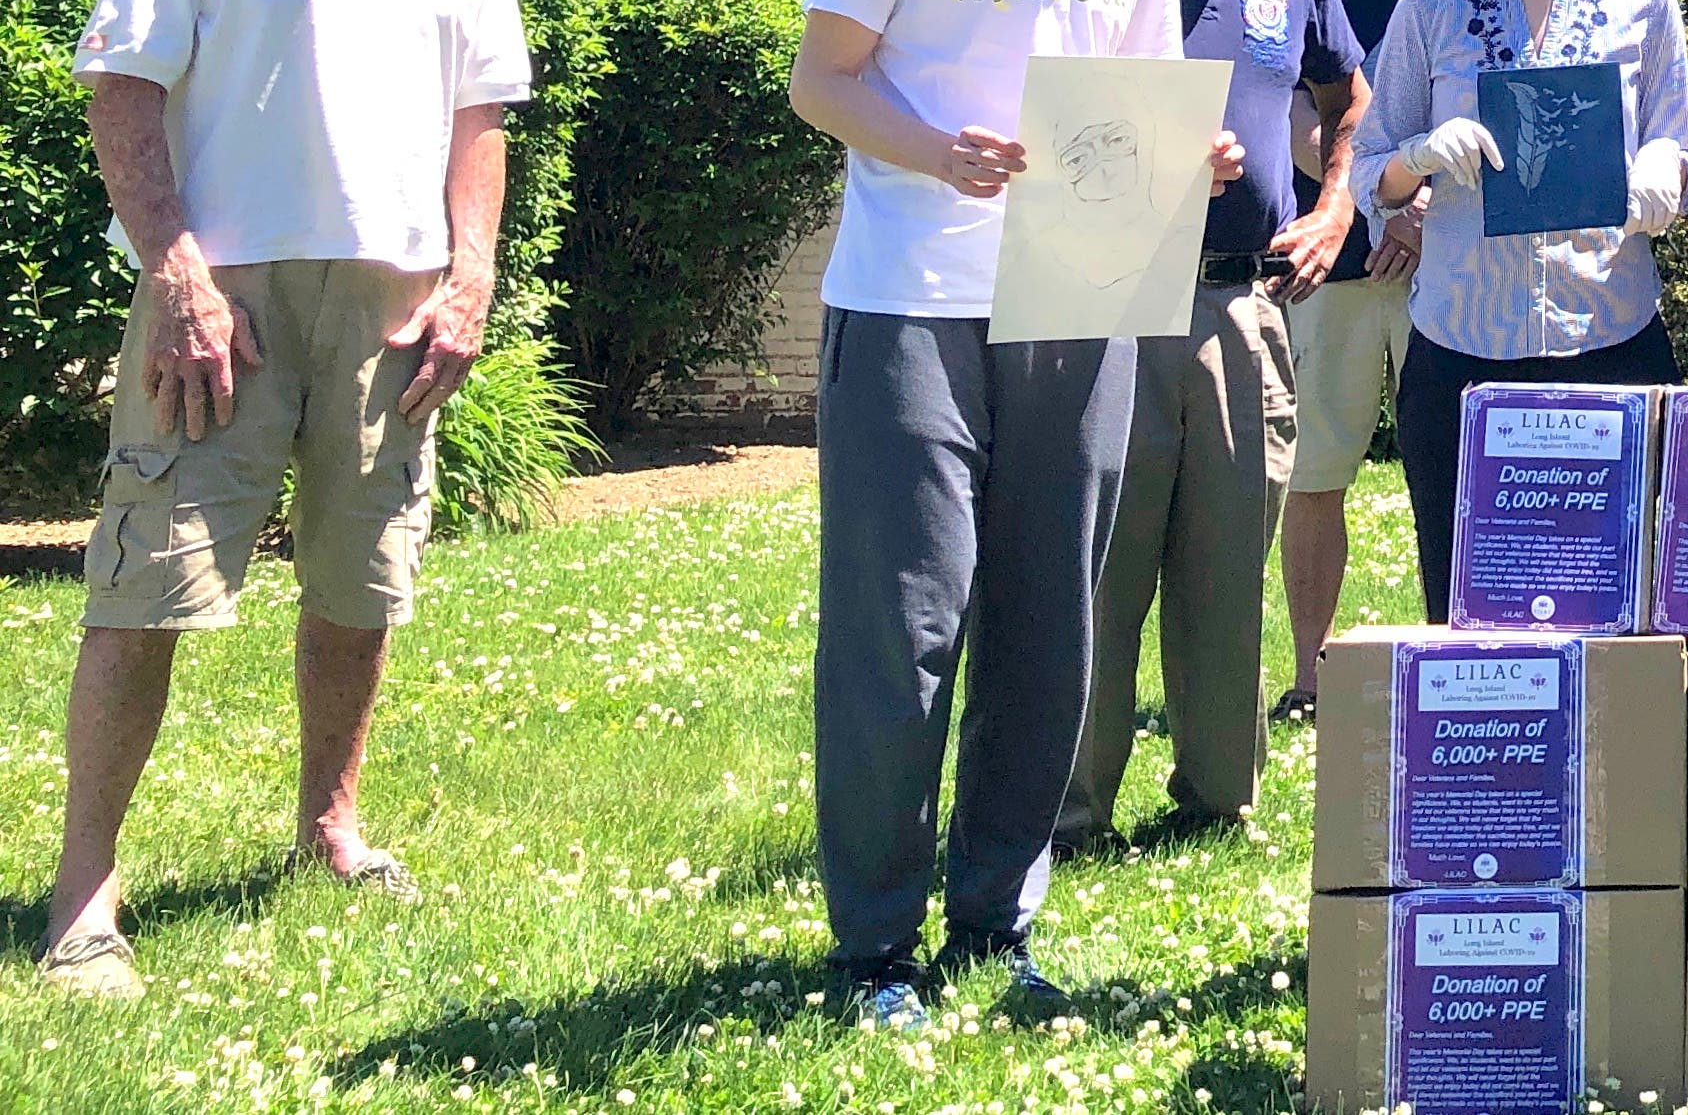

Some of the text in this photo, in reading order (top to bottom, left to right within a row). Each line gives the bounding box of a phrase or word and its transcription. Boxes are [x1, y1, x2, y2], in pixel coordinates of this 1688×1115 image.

[1521, 413, 1586, 428] LILAC
[1499, 465, 1609, 485] Donation of
[1494, 490, 1608, 511] 6,000+ PPE
[1455, 663, 1521, 679] LILAC
[1434, 718, 1547, 738] Donation of
[1432, 744, 1547, 766] 6,000+ PPE
[1452, 917, 1520, 934] LILAC
[1431, 974, 1546, 993] Donation of
[1428, 1001, 1546, 1023] 6,000+ PPE
